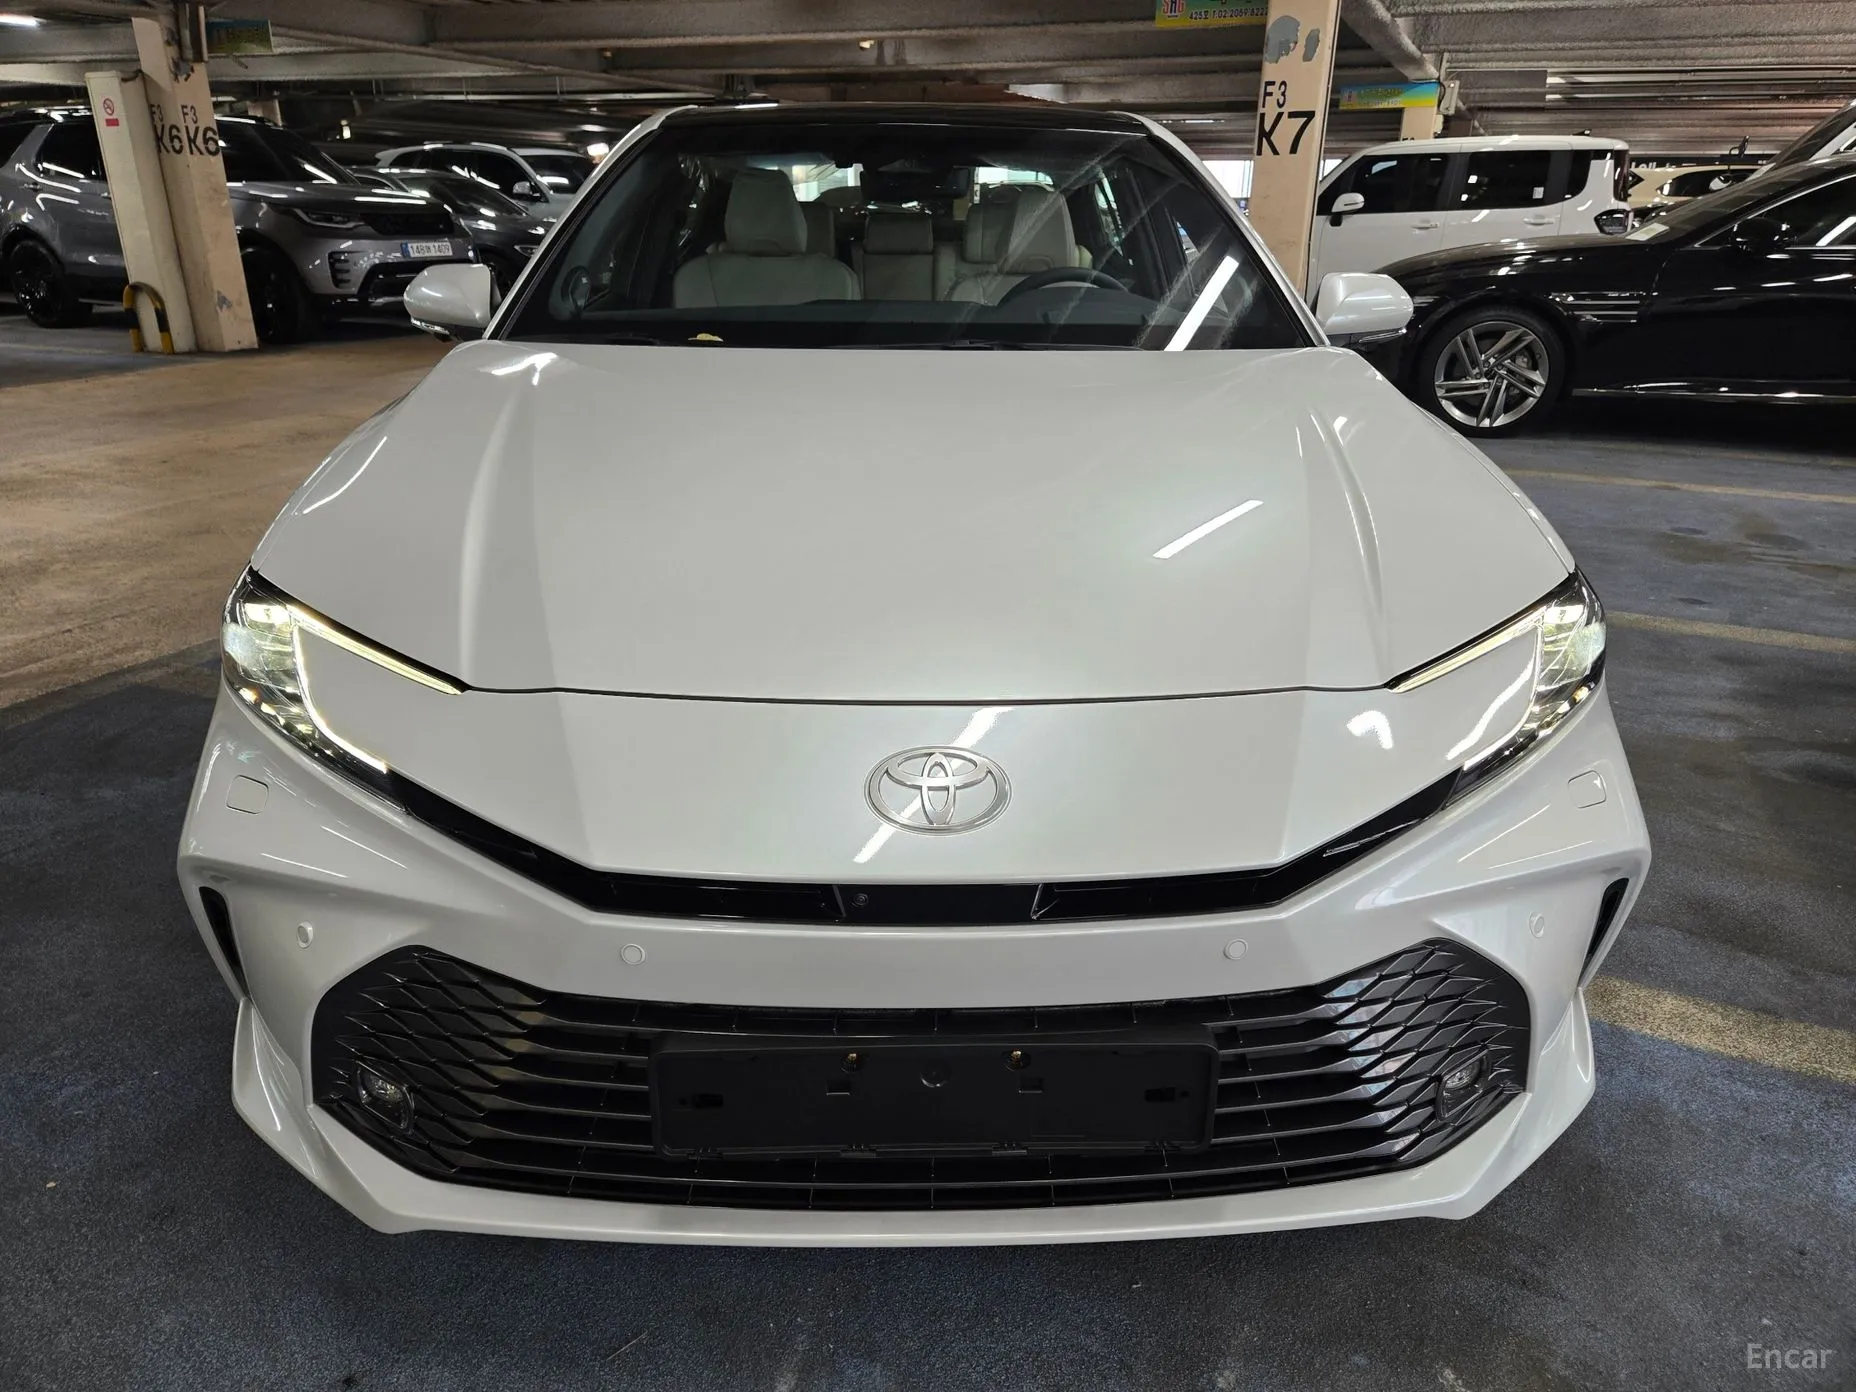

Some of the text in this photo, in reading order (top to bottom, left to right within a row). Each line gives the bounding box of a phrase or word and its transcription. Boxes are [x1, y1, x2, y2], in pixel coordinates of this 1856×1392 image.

[1262, 80, 1287, 108] F3
[149, 103, 164, 122] F3
[181, 104, 198, 124] F3
[153, 123, 184, 154] K6
[184, 125, 220, 156] K6
[1256, 110, 1316, 156] K7
